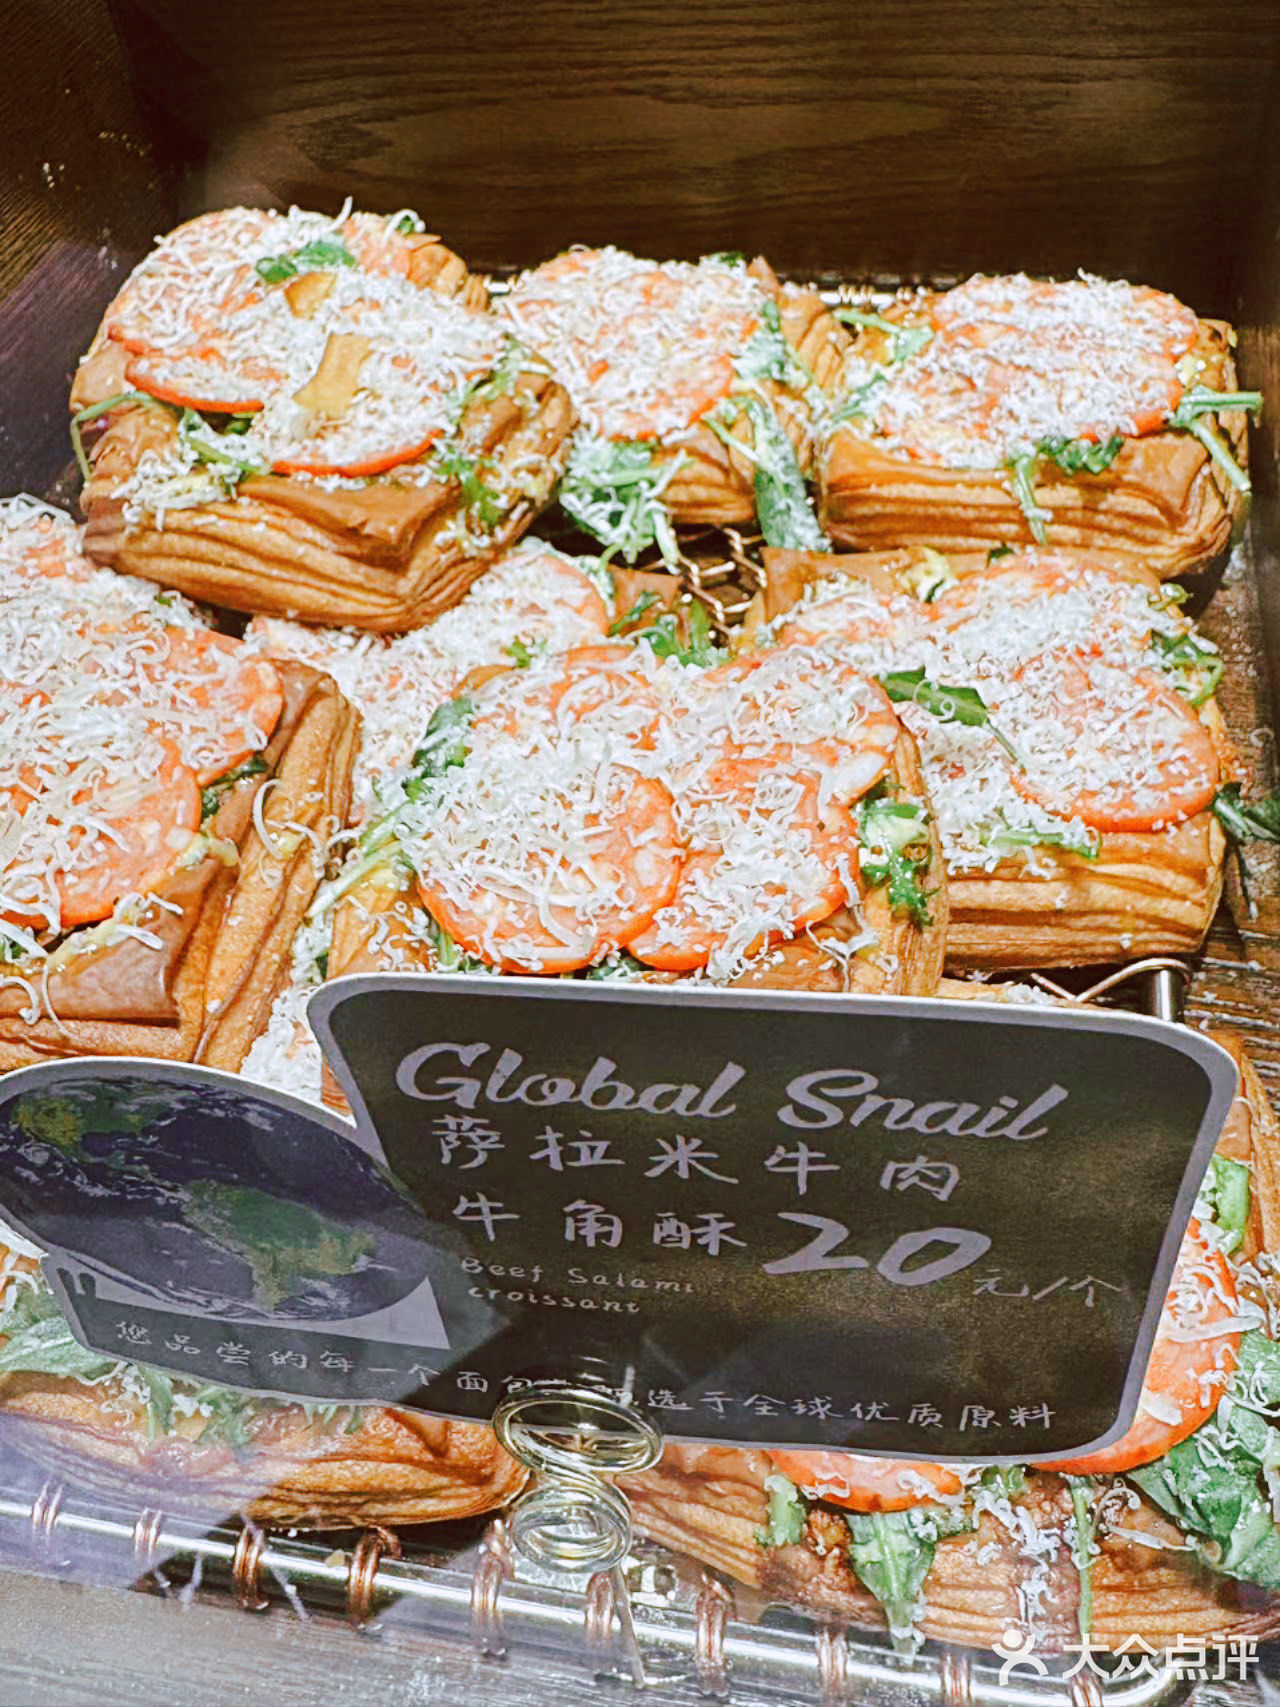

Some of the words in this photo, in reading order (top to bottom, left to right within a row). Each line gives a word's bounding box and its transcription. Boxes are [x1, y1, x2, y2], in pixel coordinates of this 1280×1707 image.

[396, 1042, 746, 1118] Global
[777, 1069, 1069, 1140] Snail
[432, 1114, 960, 1201] 萨拉米牛肉
[453, 1192, 748, 1256] 牛角酥
[762, 1212, 991, 1286] 20
[461, 1257, 543, 1283] Beef
[567, 1268, 694, 1293] Salami
[468, 1286, 640, 1313] croissant
